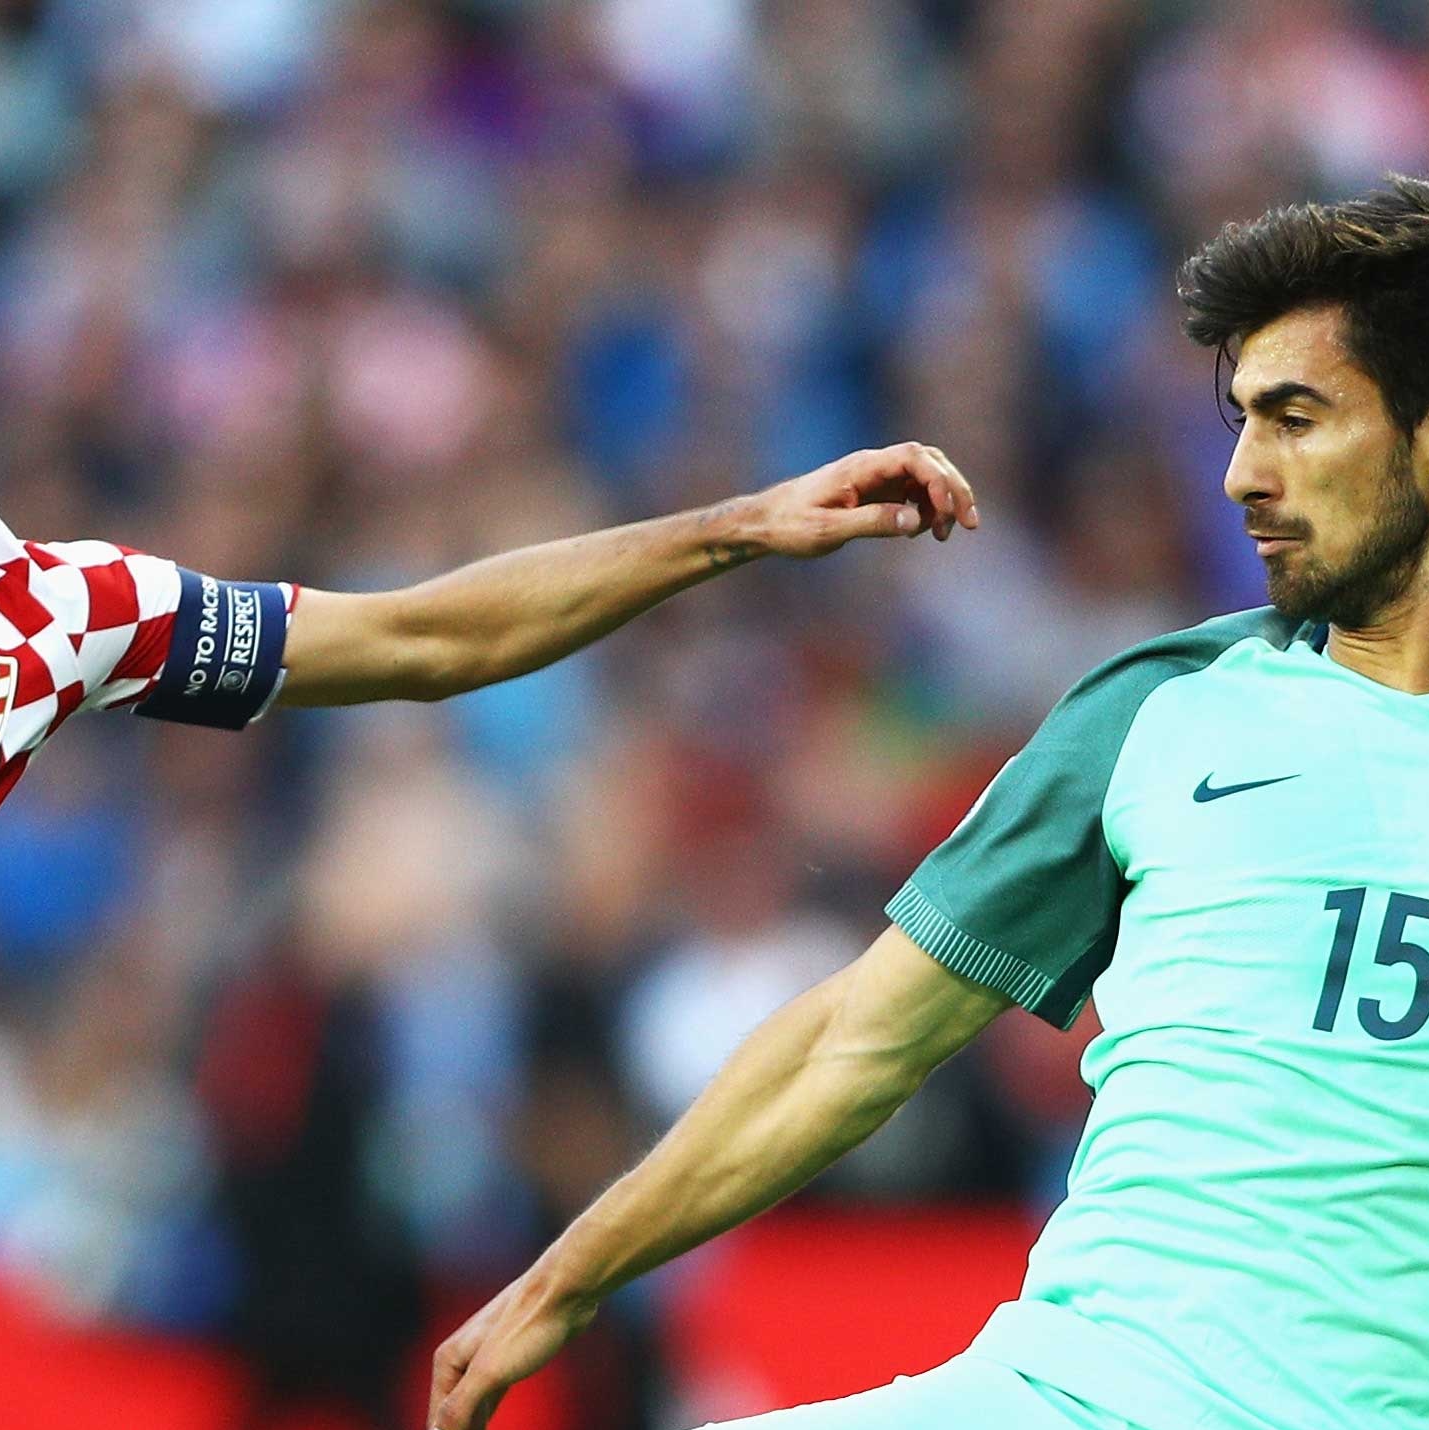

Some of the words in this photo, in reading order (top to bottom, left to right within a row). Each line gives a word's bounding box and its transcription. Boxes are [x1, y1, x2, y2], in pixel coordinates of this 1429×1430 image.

[200, 575, 220, 633] RACIS
[231, 588, 255, 664] RESPECT
[194, 636, 215, 666] TO
[183, 669, 207, 696] NO
